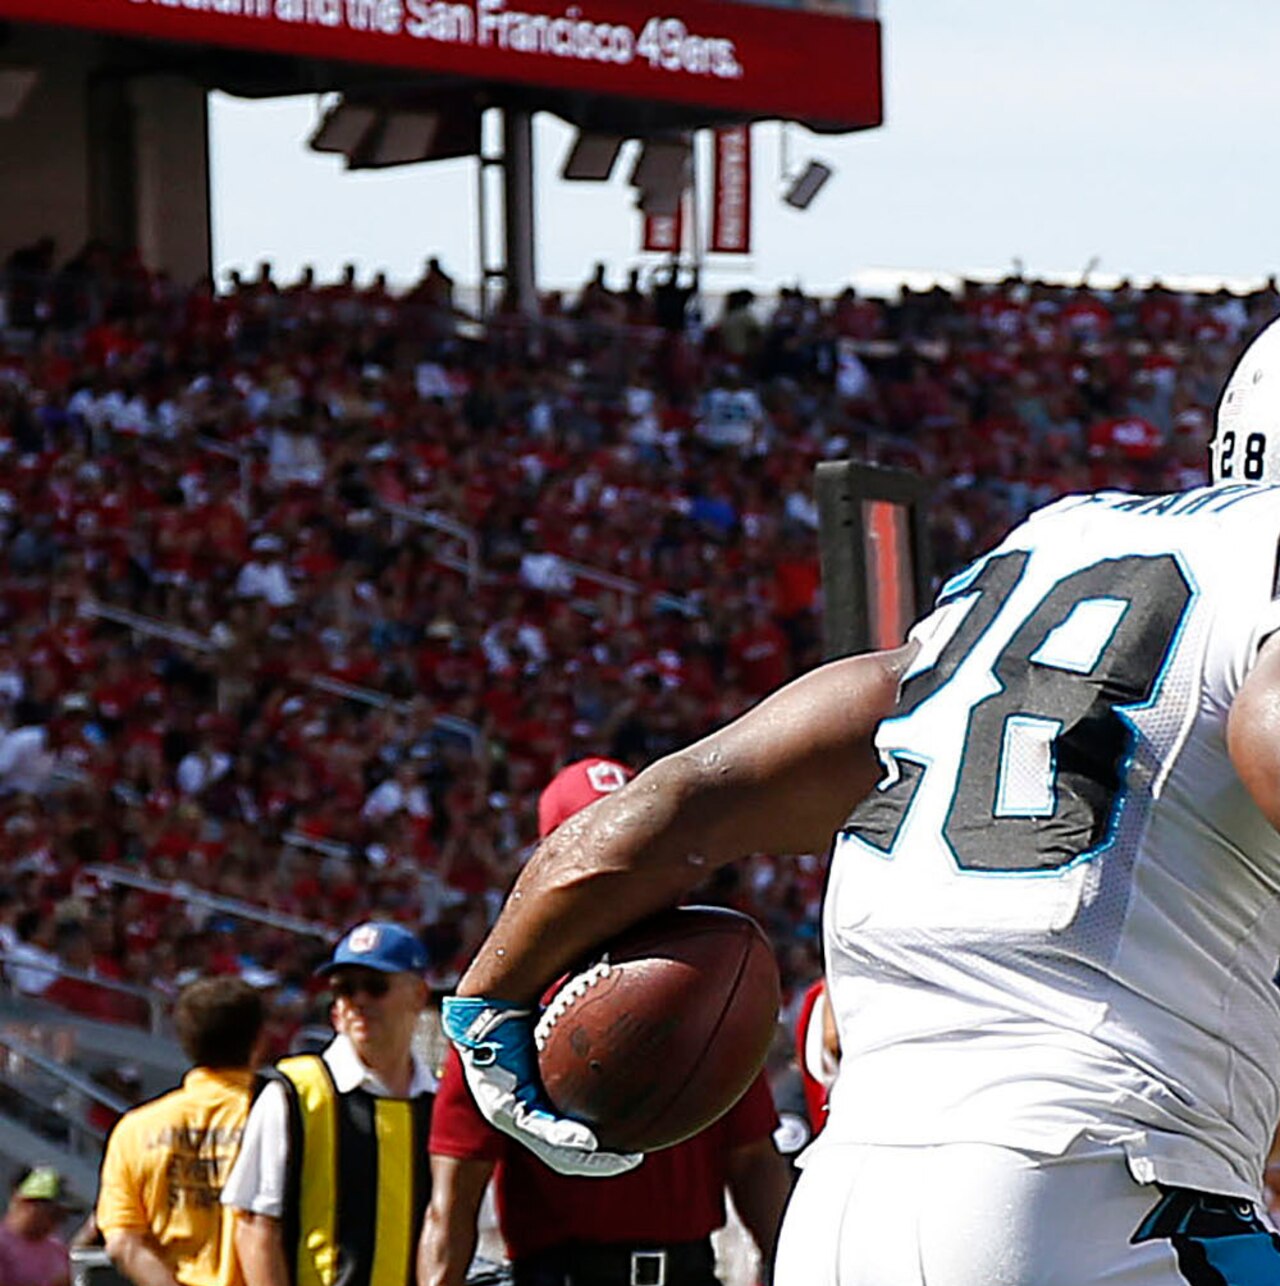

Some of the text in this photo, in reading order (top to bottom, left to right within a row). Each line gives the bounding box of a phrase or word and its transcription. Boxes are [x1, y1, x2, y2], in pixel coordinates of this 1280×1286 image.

[405, 0, 473, 43] San
[477, 0, 634, 64] Francisco
[637, 17, 743, 79] 49ers.
[1220, 430, 1266, 480] 28
[842, 548, 1202, 877] 28
